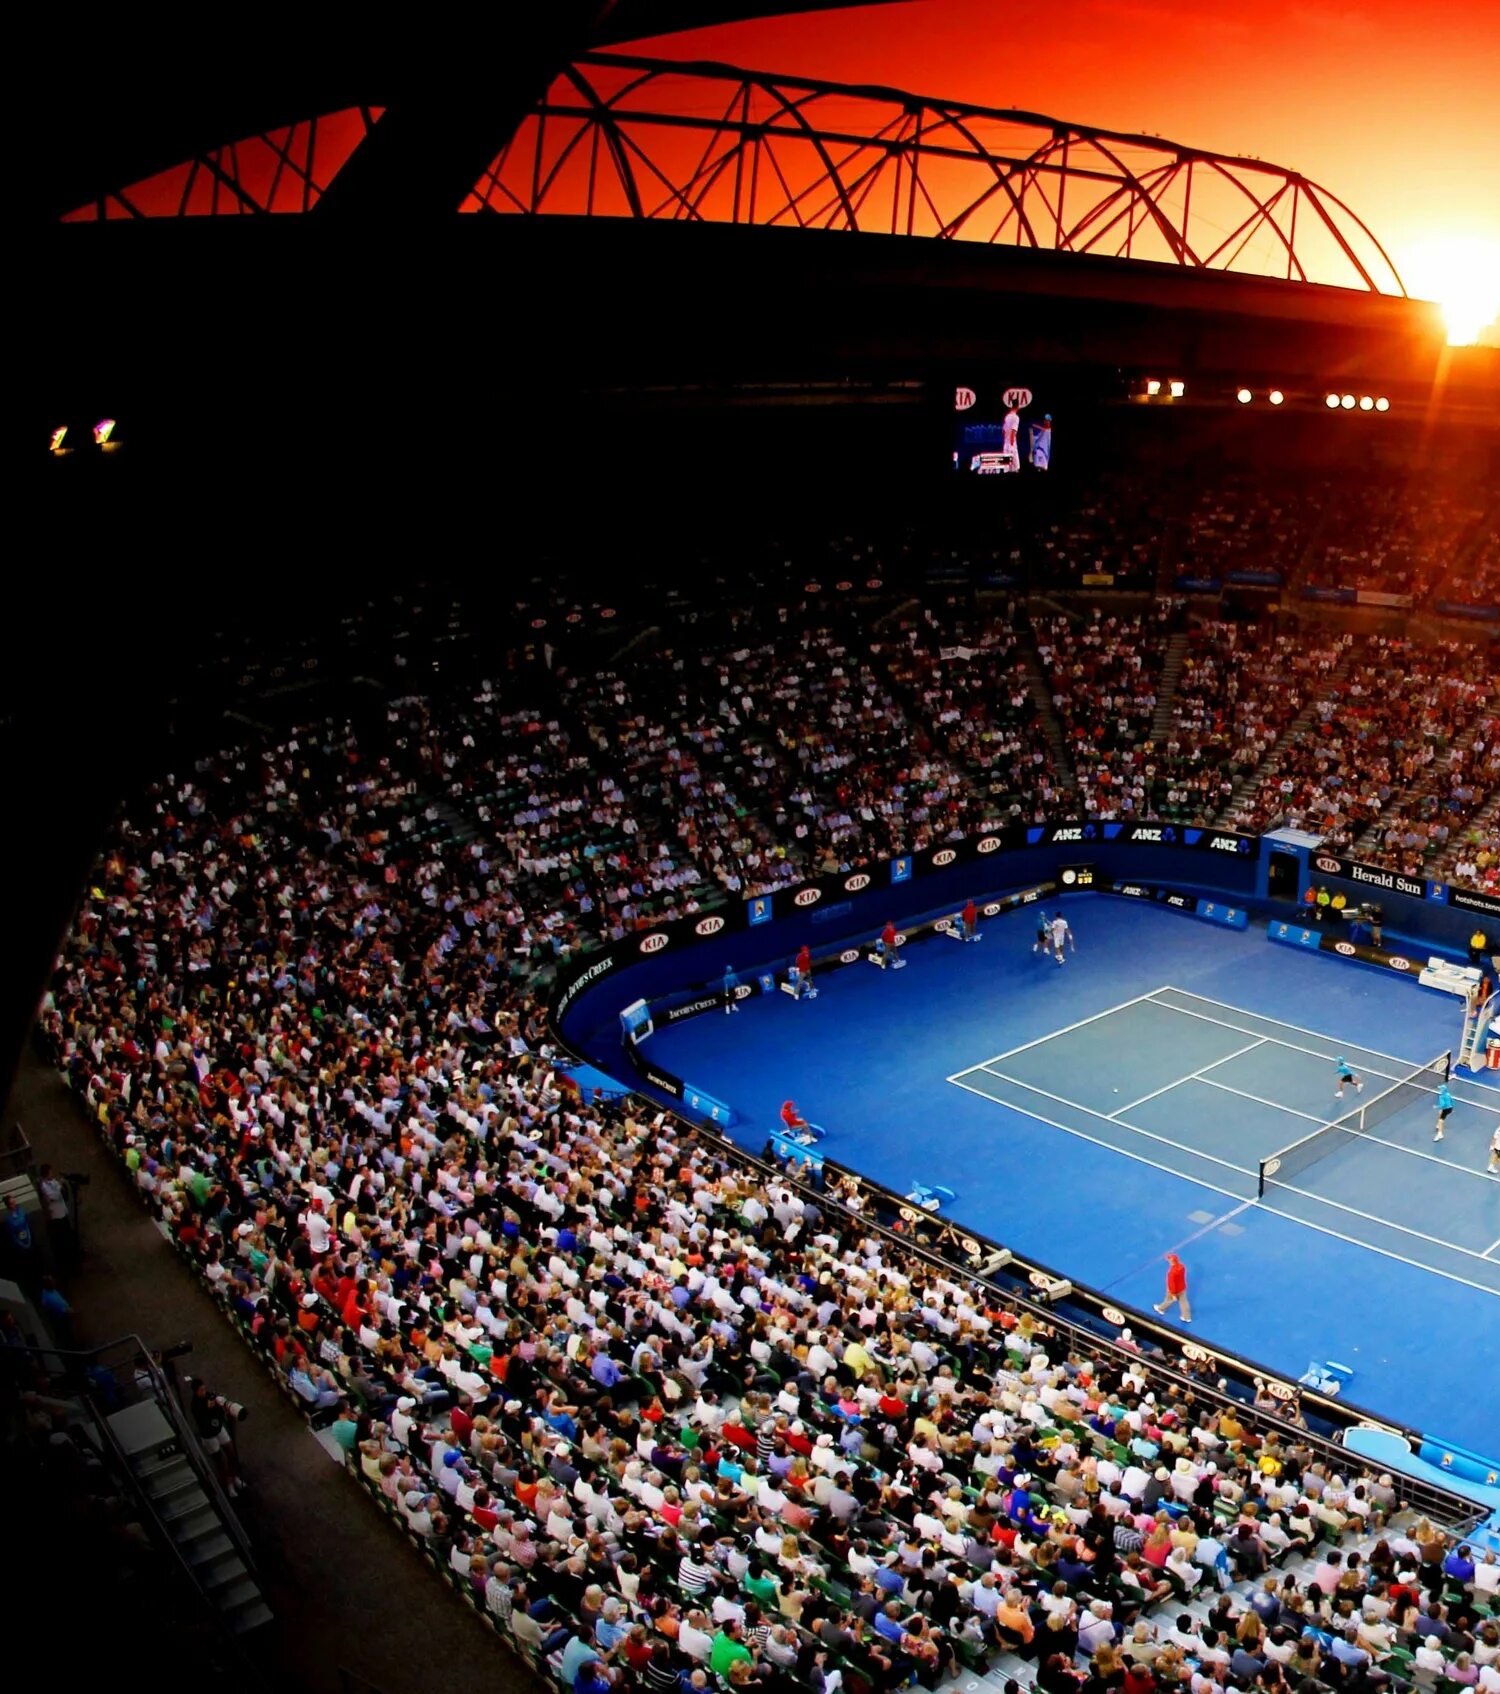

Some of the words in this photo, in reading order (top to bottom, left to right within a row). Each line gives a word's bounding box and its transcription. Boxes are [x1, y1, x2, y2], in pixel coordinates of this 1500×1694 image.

[1052, 828, 1082, 841] ANZ
[1131, 828, 1162, 841] ANZ
[979, 838, 999, 852] KIA
[1210, 837, 1238, 852] ANZ
[935, 851, 954, 865] KIA
[1319, 859, 1338, 872] KIA
[848, 875, 868, 890] KIA
[1352, 866, 1393, 888] Herald
[1396, 878, 1421, 895] Sun
[799, 890, 819, 904] KIA
[1023, 892, 1038, 903] ANZ
[1122, 886, 1141, 896] ANZ
[1167, 896, 1184, 907] ANZ
[700, 918, 722, 934] KIA
[644, 935, 666, 951] KIA
